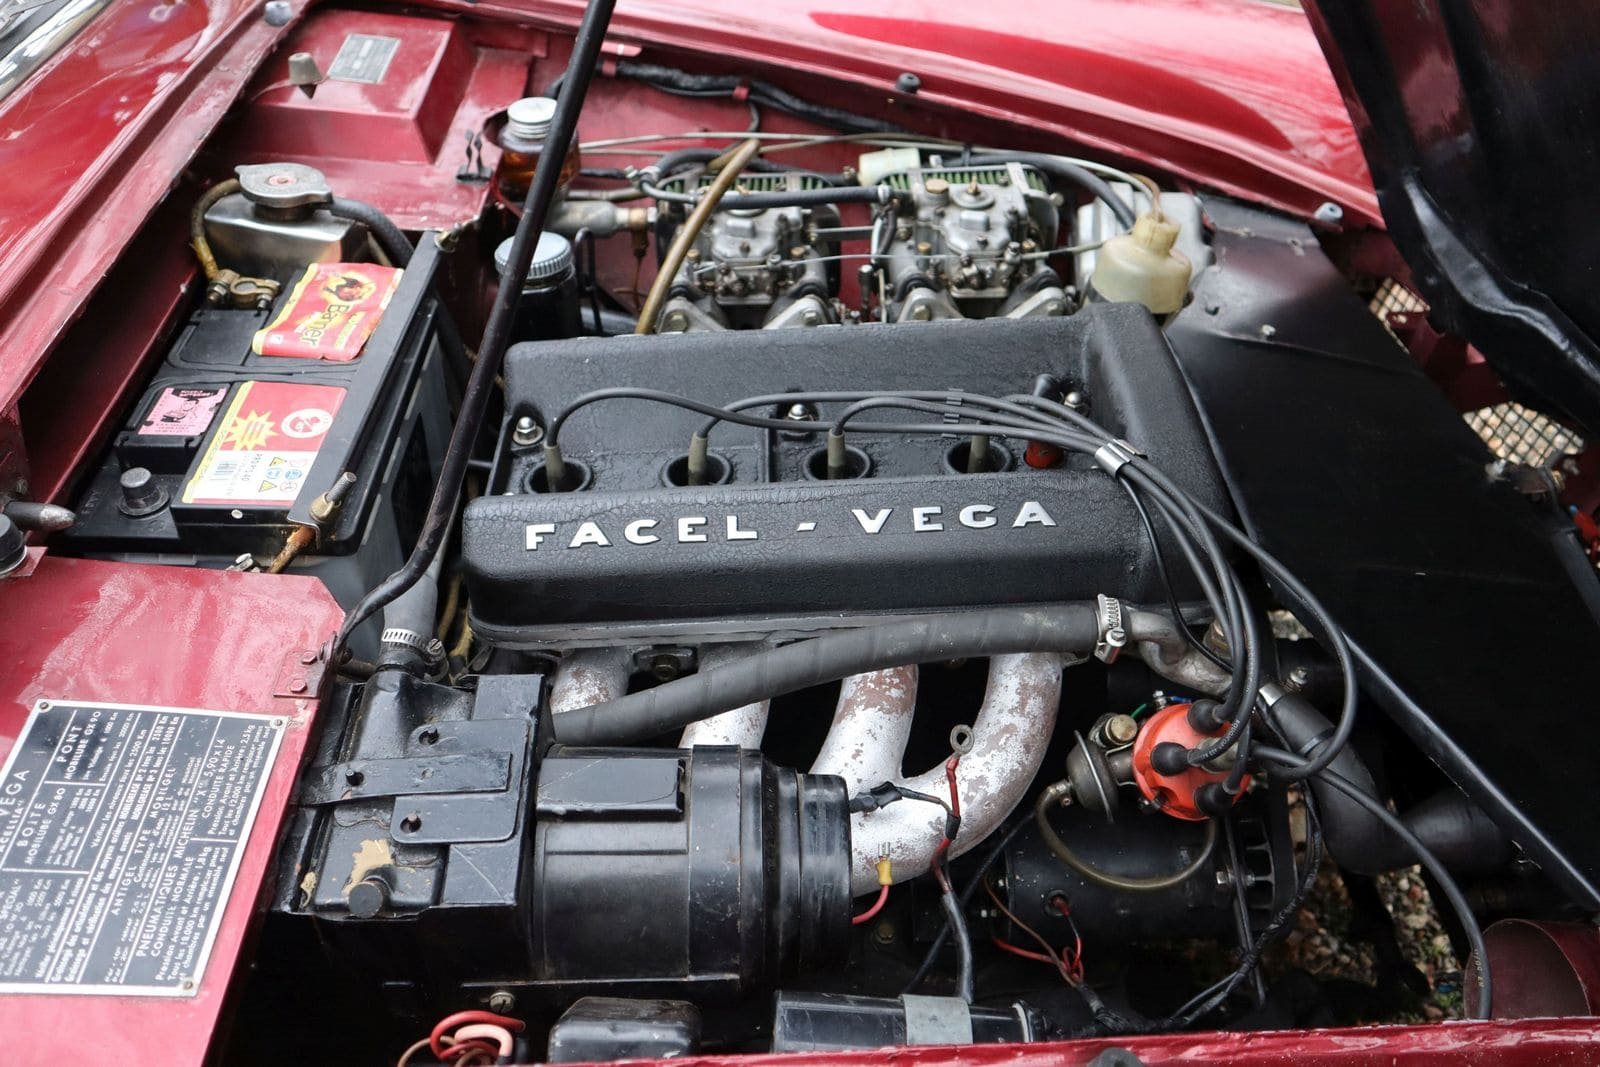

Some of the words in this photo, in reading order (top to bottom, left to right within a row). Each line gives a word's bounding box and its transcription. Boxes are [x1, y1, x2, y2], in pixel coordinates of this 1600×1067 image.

[526, 514, 758, 550] FACEL
[797, 521, 816, 532] -
[852, 501, 1056, 534] VEGA
[56, 726, 81, 762] PONT
[64, 739, 88, 779] MOBILUBE
[129, 740, 142, 756] 2500
[141, 755, 152, 767] tous
[152, 725, 168, 740] 2500
[201, 775, 223, 818] CONDUITE
[218, 745, 235, 772] RAPIDE
[207, 806, 224, 834] Pression
[219, 782, 232, 804] Avant
[25, 819, 51, 864] MOBILUBE
[111, 866, 136, 915] ANTIGEL
[134, 829, 151, 854] TYPE
[149, 768, 175, 818] MOBILGEL
[133, 842, 155, 882] Contenance
[136, 866, 177, 956] PNEUMATIQUES
[173, 809, 199, 858] MICHELIN
[203, 757, 219, 777] 5,90
[151, 906, 176, 956] CONDUITE
[171, 857, 195, 901] NORMALE
[155, 945, 175, 980] Pression
[171, 917, 185, 942] Avant
[167, 962, 181, 980] Tous
